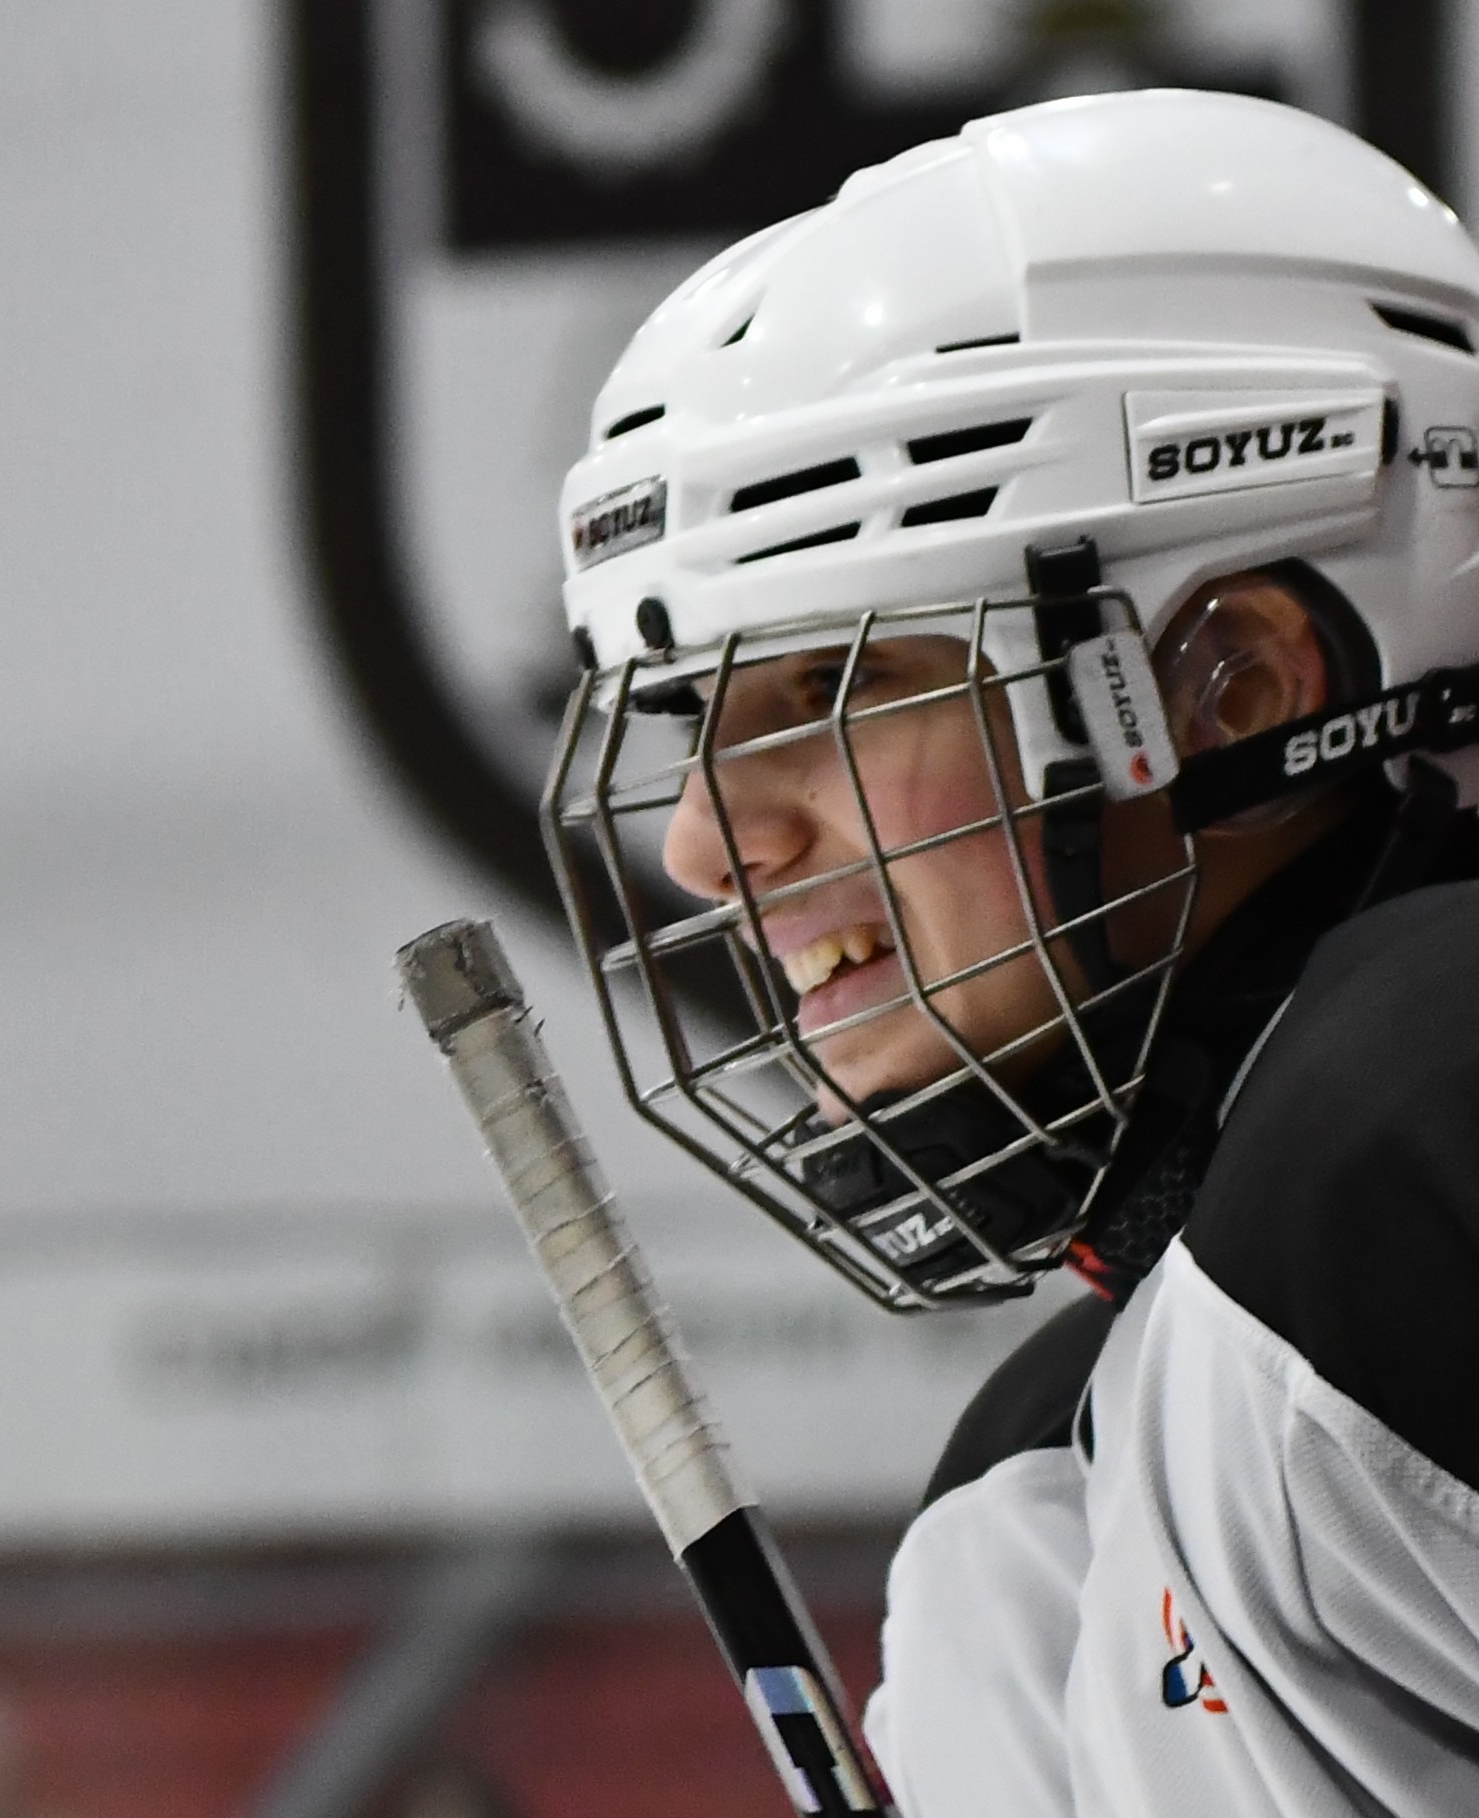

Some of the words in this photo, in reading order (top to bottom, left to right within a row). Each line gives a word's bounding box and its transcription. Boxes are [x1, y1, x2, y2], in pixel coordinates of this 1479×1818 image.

[1148, 417, 1326, 481] SOYUZ
[1101, 653, 1143, 748] SOYUZ
[1284, 689, 1451, 776] SOYU
